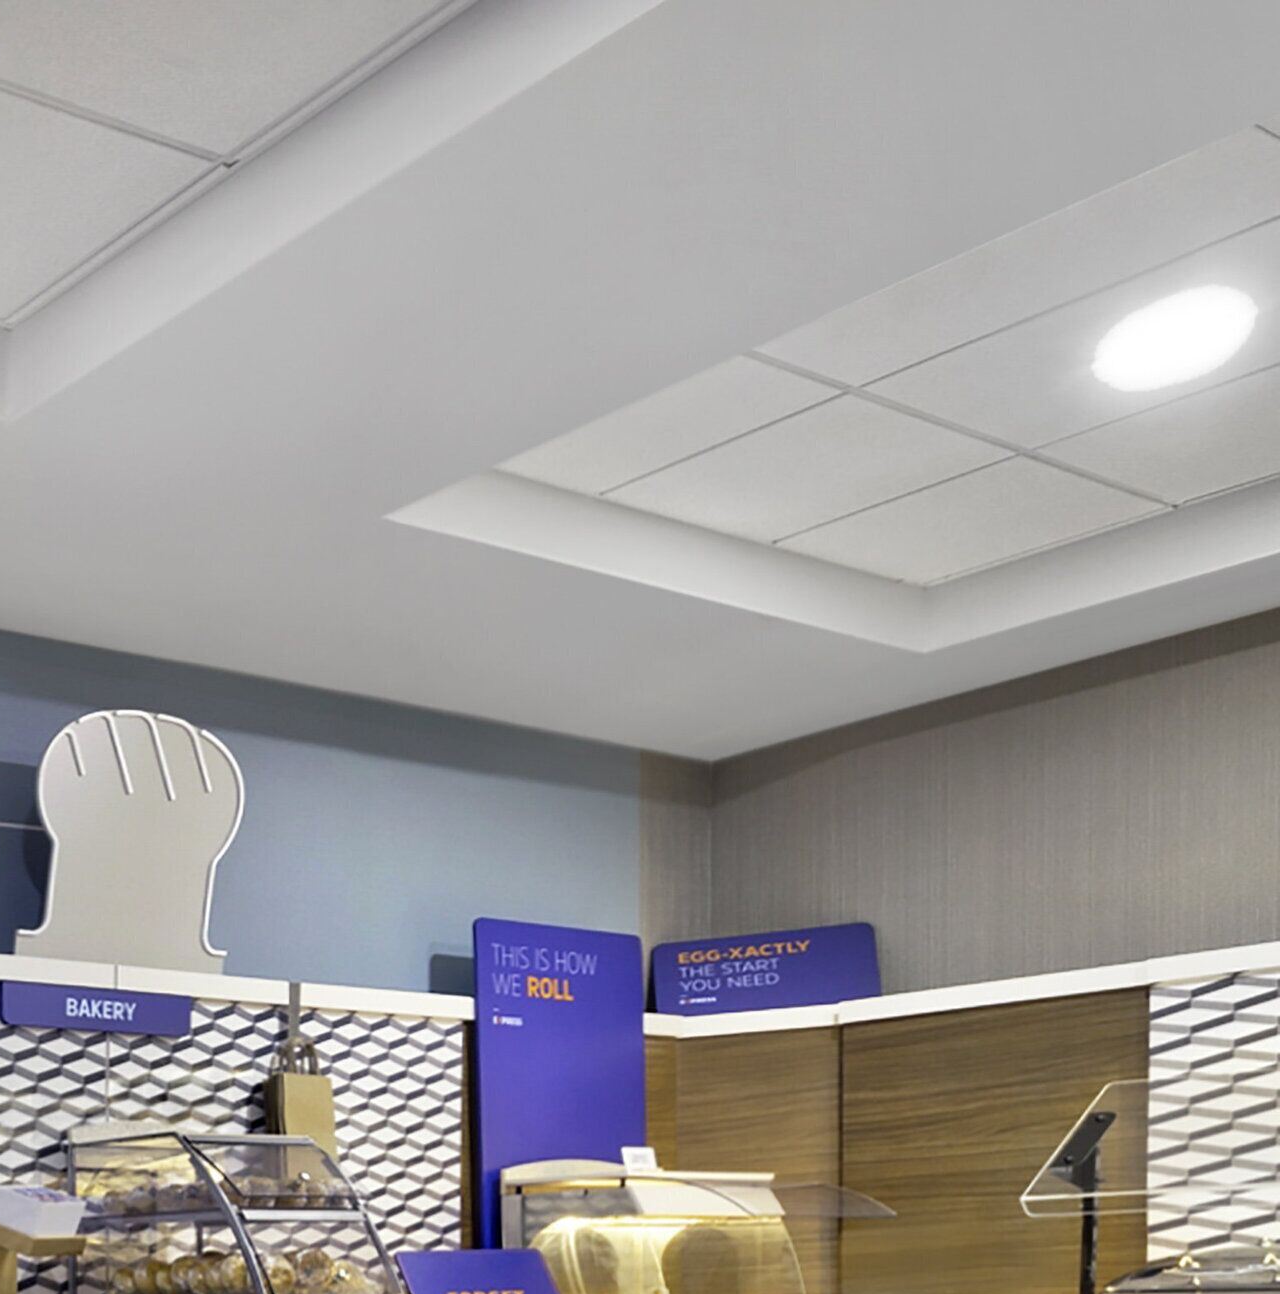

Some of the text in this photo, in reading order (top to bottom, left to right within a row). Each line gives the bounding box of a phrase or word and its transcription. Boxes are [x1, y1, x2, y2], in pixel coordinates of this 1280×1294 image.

[491, 942, 598, 975] THIS IS HOW
[678, 939, 811, 964] EGG-XACTLY
[679, 957, 780, 979] THE START
[491, 973, 575, 1001] WE ROLL
[679, 972, 780, 992] YOU NEED
[66, 997, 137, 1021] BAKERY
